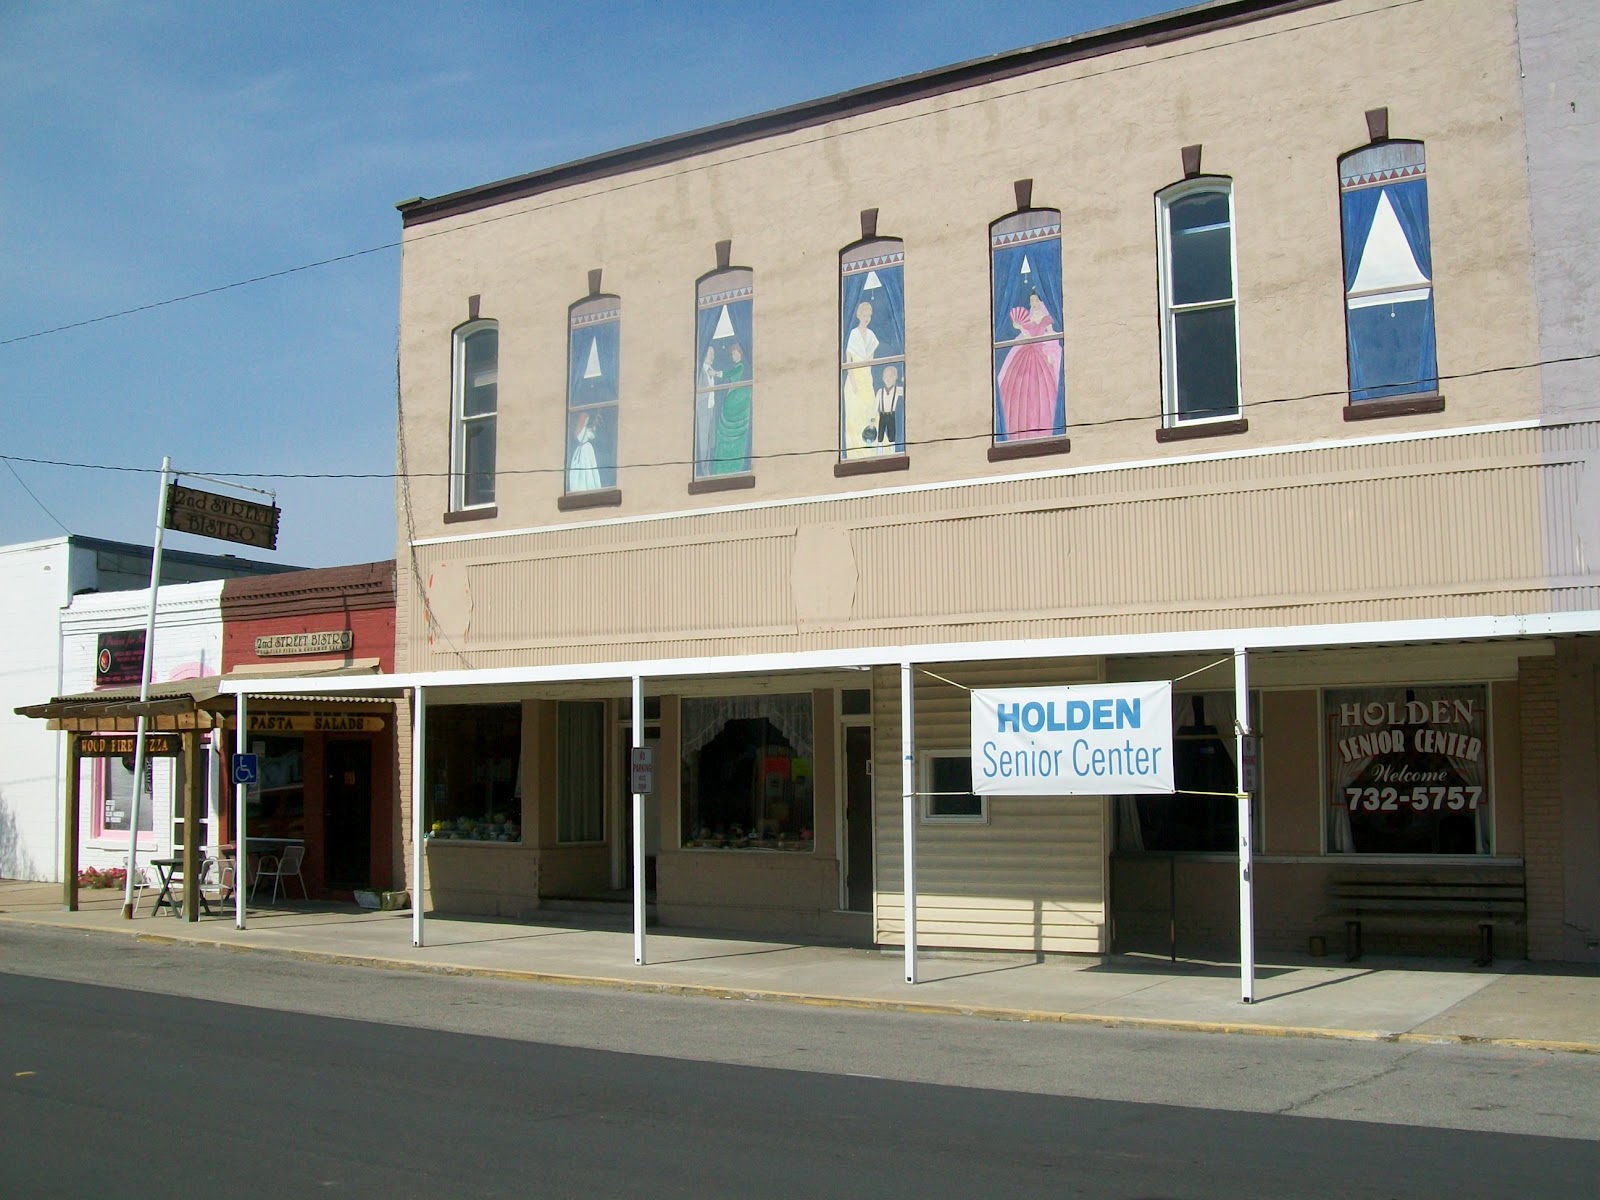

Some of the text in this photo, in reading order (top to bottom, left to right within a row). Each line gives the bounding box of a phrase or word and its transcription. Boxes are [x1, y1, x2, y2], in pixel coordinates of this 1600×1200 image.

[177, 491, 272, 523] 2nd STREET
[188, 514, 255, 541] BISTRO
[256, 632, 350, 649] 2nd STREET BISTRO
[250, 716, 364, 730] PASTA SALADS
[997, 697, 1142, 733] HOLDEN
[1339, 699, 1475, 727] HOLDEN
[81, 739, 106, 753] WOOD
[111, 739, 133, 753] FIRE
[982, 738, 1162, 778] Senior Center
[1338, 728, 1482, 763] SENIOR CENTER
[1371, 763, 1448, 783] Welcome
[1346, 786, 1483, 812] 732-5757
